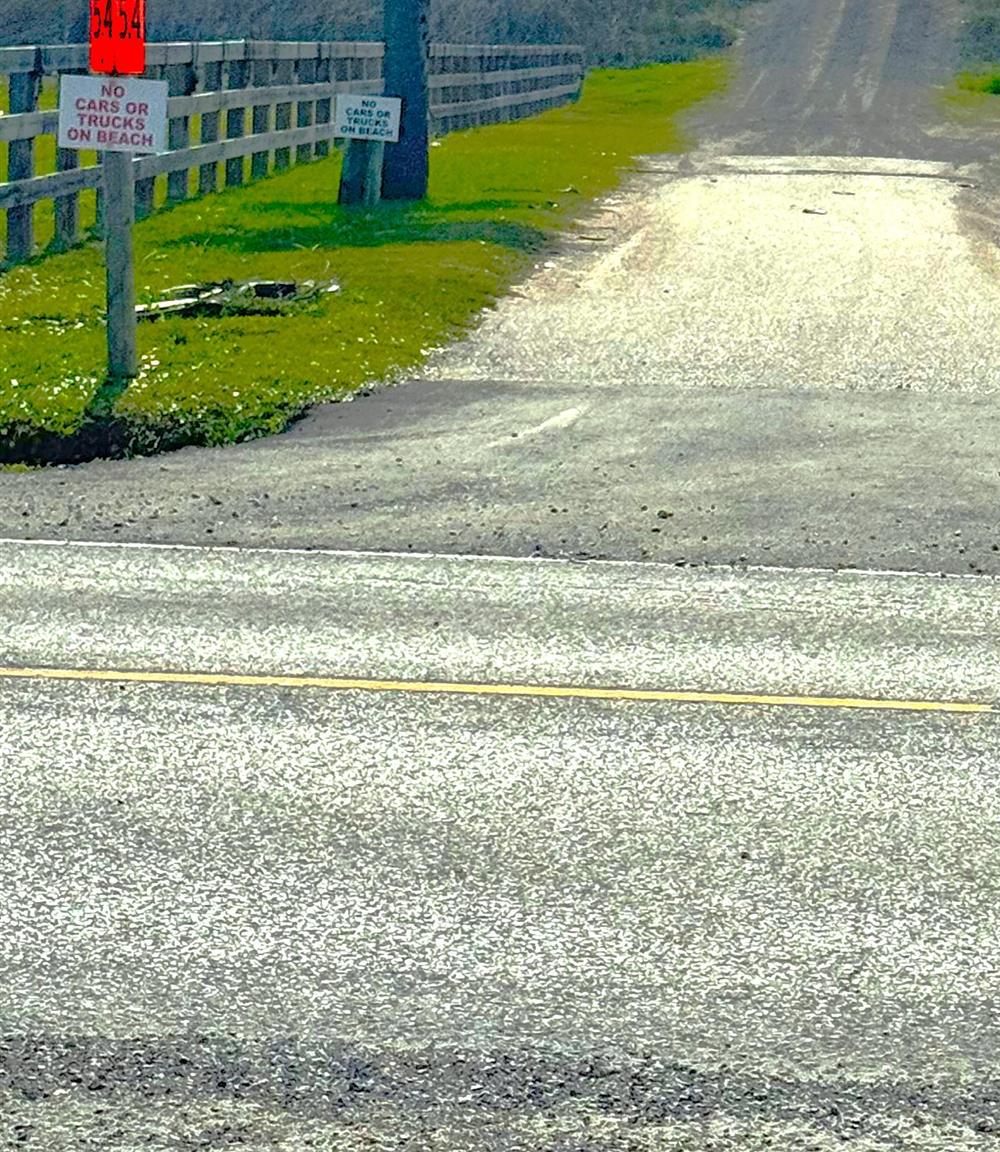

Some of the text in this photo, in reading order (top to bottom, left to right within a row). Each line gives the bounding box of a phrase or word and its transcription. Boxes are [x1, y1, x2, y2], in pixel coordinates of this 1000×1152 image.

[101, 84, 125, 98] NO
[75, 98, 149, 115] CARS OR
[361, 100, 377, 108] NO
[346, 108, 391, 118] CARS OR
[78, 114, 145, 130] TRUCKS
[347, 117, 388, 127] TRUCKS
[67, 127, 153, 146] ON BEACH
[340, 126, 393, 136] ON BEACH
